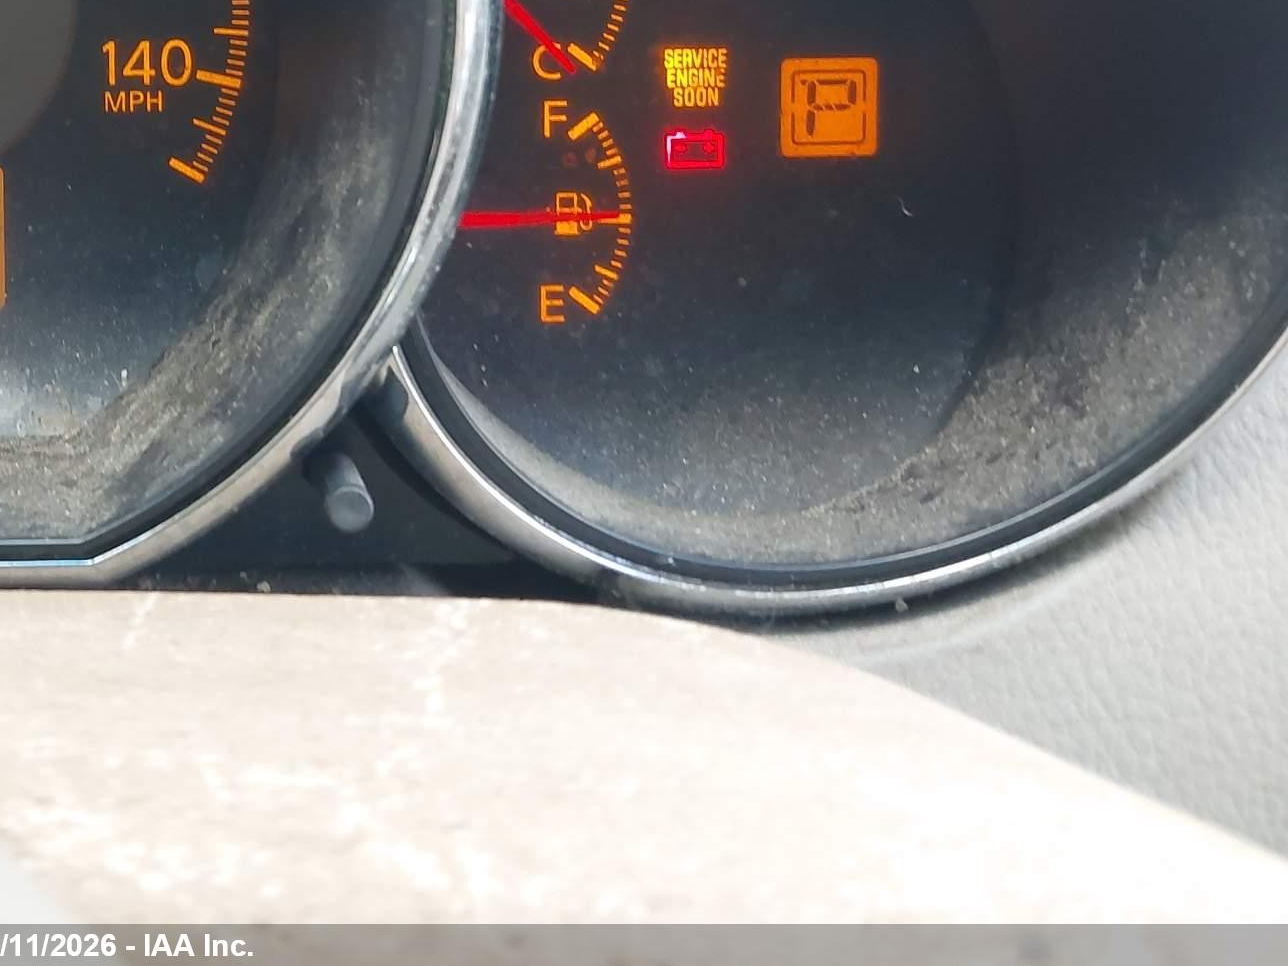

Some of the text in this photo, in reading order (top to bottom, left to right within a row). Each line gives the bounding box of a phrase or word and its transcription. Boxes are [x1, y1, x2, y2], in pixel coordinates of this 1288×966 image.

[102, 38, 194, 88] 140
[531, 41, 564, 81] C
[664, 47, 728, 69] SERVICE
[666, 67, 726, 89] ENGINE
[103, 90, 165, 113] MPH
[672, 86, 720, 108] SOON
[799, 78, 858, 138] P
[542, 99, 568, 139] F
[540, 284, 566, 324] E
